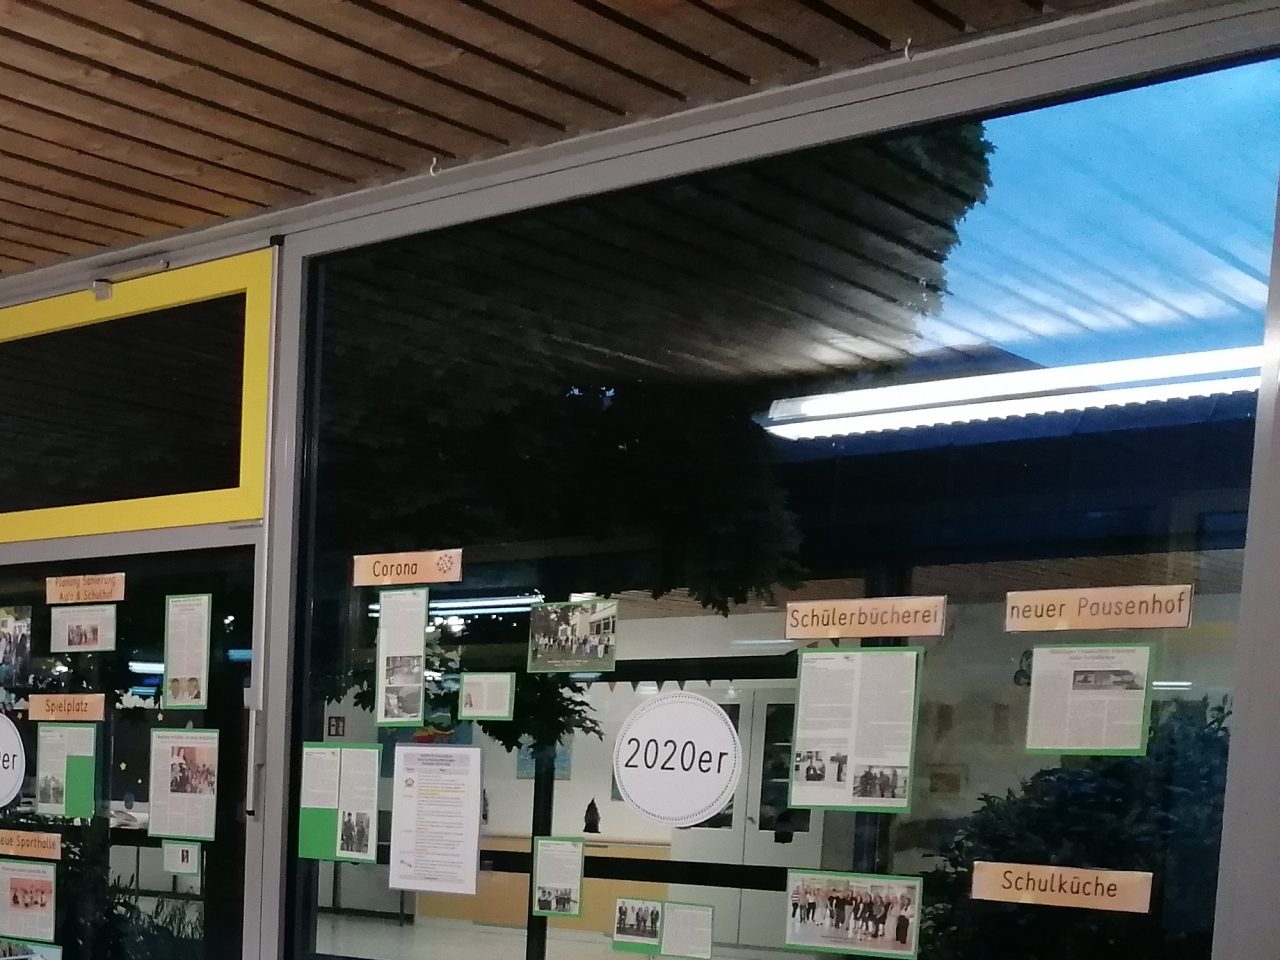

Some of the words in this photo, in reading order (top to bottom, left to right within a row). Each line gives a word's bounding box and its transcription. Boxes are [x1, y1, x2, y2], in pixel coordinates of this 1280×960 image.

[372, 559, 418, 578] Corona
[82, 575, 117, 587] Sanierung
[83, 589, 113, 600] Schulhof
[789, 602, 939, 628] Schülerbücherei
[1009, 601, 1067, 620] neuer
[1076, 591, 1187, 617] Pausenhof
[45, 698, 89, 716] Spielplatz
[624, 737, 728, 775] 2020er
[16, 835, 57, 851] Sporthalle
[1001, 869, 1118, 899] Schulküche
